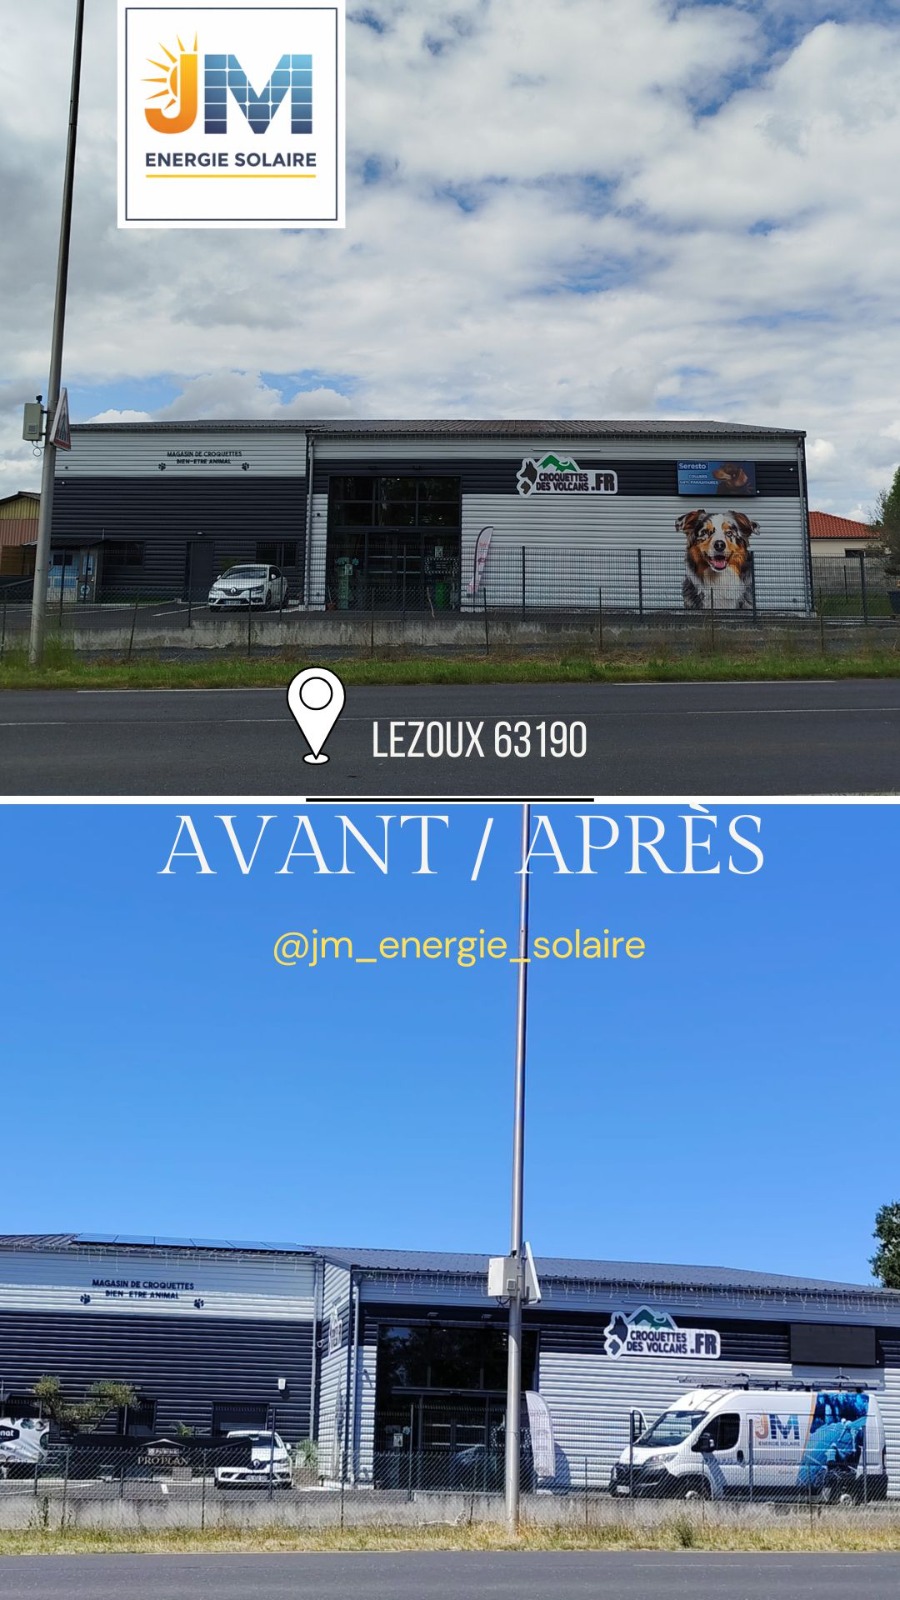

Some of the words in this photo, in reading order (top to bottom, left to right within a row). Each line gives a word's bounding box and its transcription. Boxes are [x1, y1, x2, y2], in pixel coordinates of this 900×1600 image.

[678, 462, 707, 470] Seresto
[538, 472, 589, 482] CROQUETTES
[591, 473, 615, 492] .FR
[536, 482, 551, 491] DES
[553, 482, 589, 492] VOLCANS
[91, 1279, 129, 1288] MAGASIN
[130, 1280, 141, 1288] DE
[142, 1281, 195, 1290] CROQUETTES
[149, 1291, 180, 1299] ANIMAL
[630, 1330, 687, 1343] CROQUETTES
[626, 1341, 643, 1352] DES
[646, 1342, 688, 1354] VOLCANS
[690, 1333, 717, 1355] .FR
[754, 1413, 800, 1440] JM
